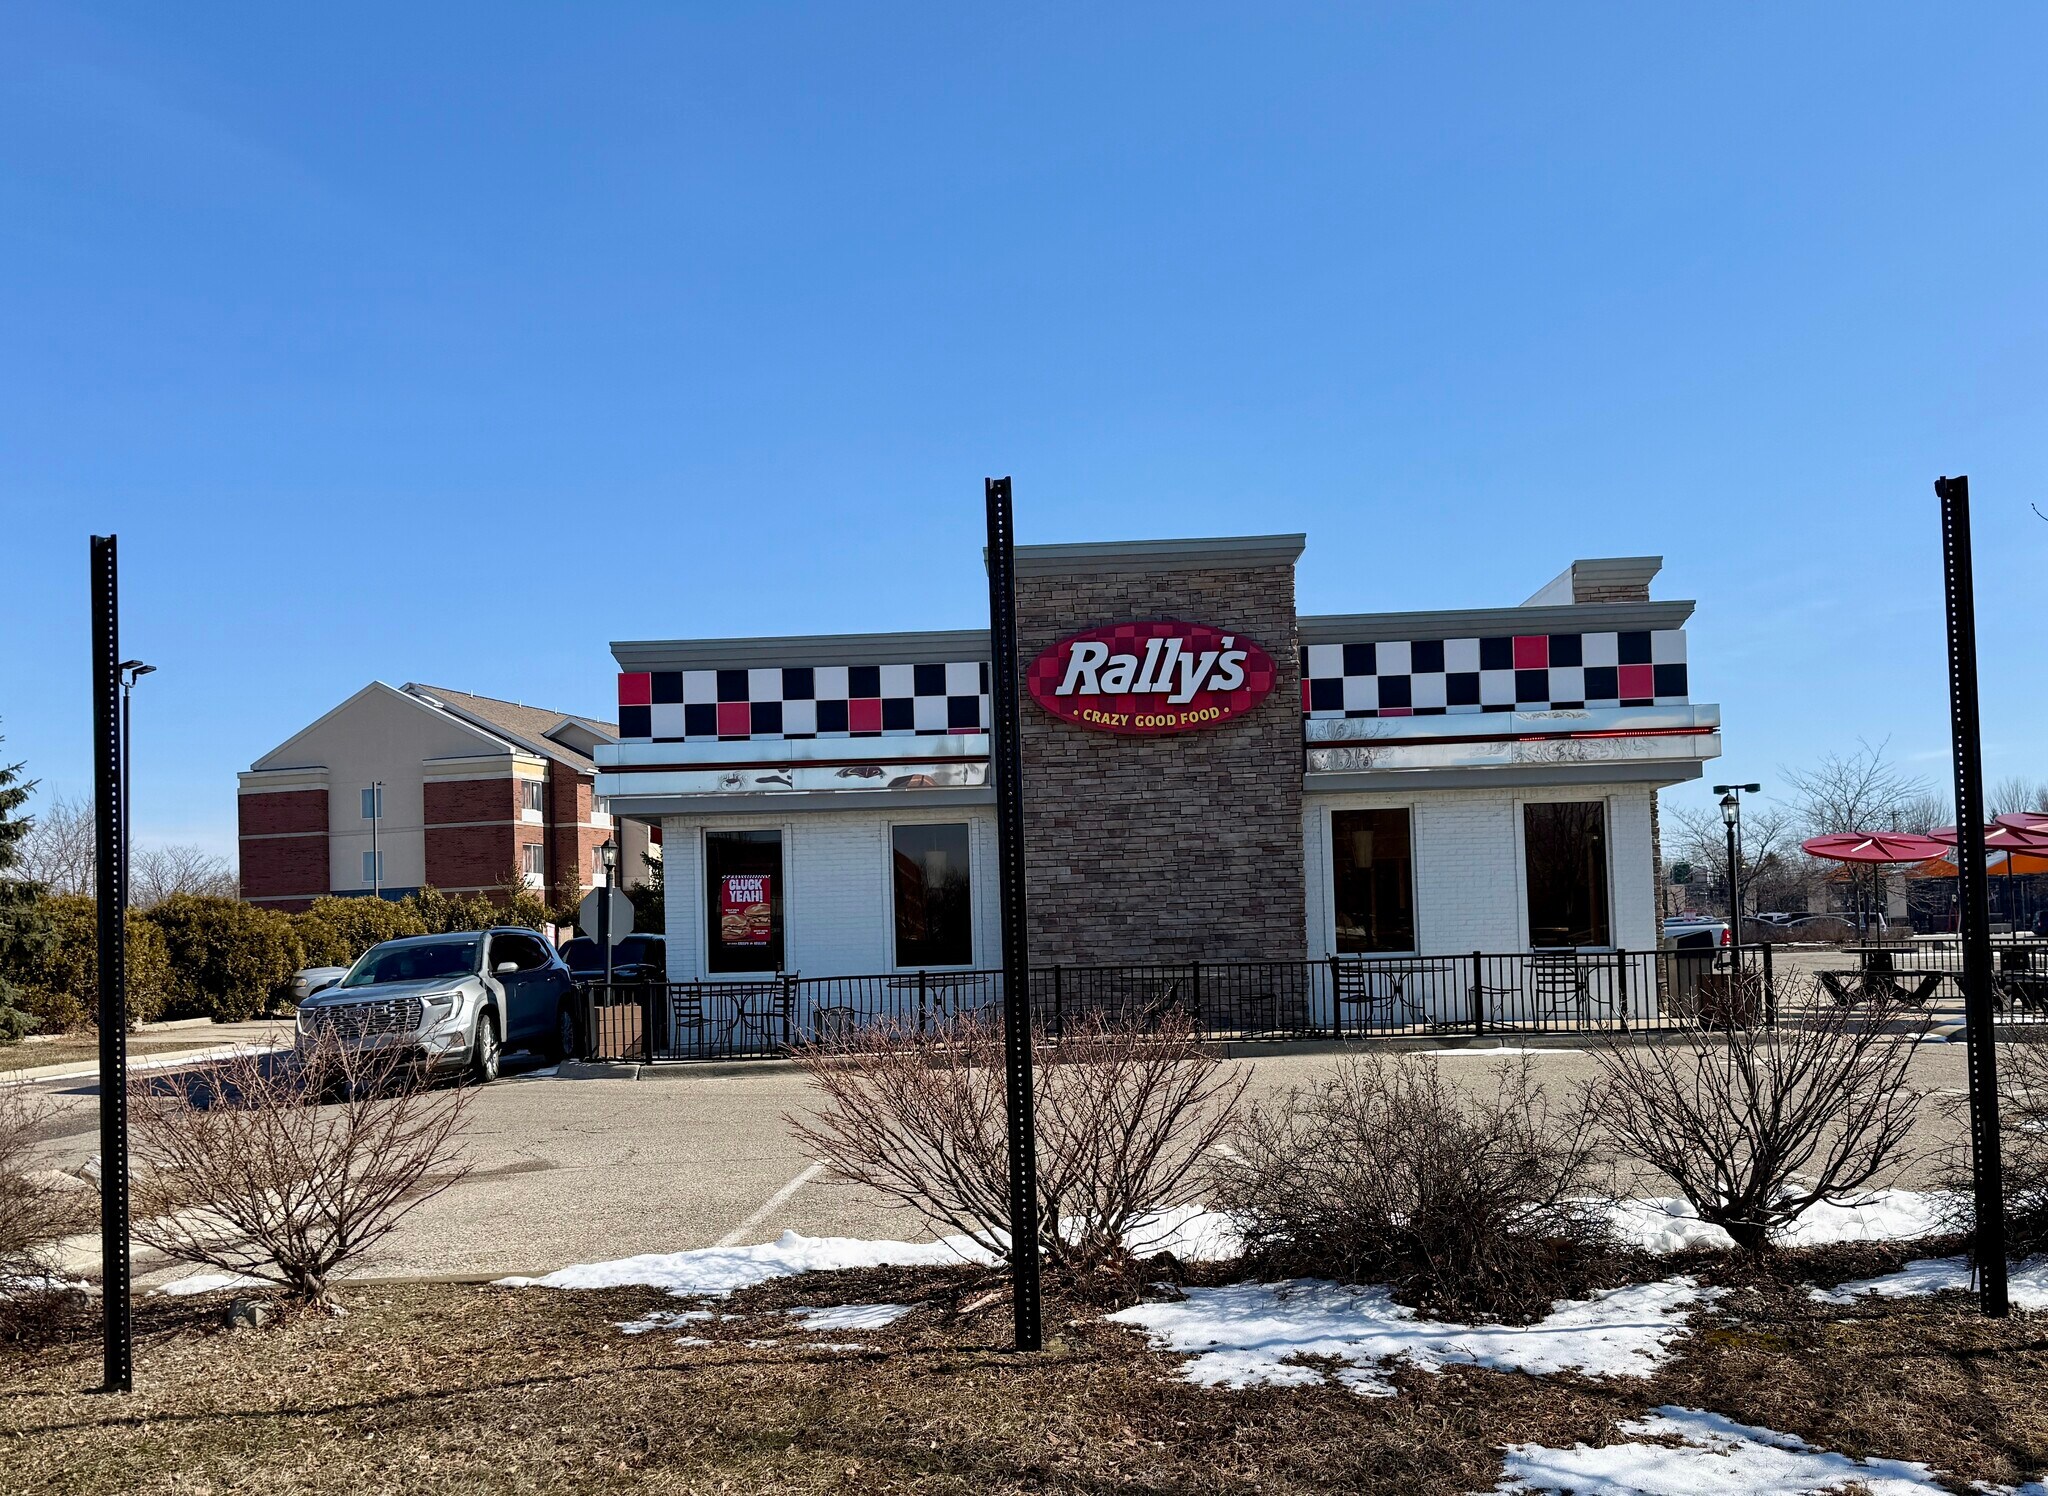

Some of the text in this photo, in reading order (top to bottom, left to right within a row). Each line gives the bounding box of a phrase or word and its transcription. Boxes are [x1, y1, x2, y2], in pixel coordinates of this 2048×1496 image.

[1055, 636, 1247, 703] Rally's
[1083, 707, 1220, 727] CRAZY GOOD FOOD
[729, 879, 762, 890] CLUCK
[729, 890, 763, 902] YEAH!
